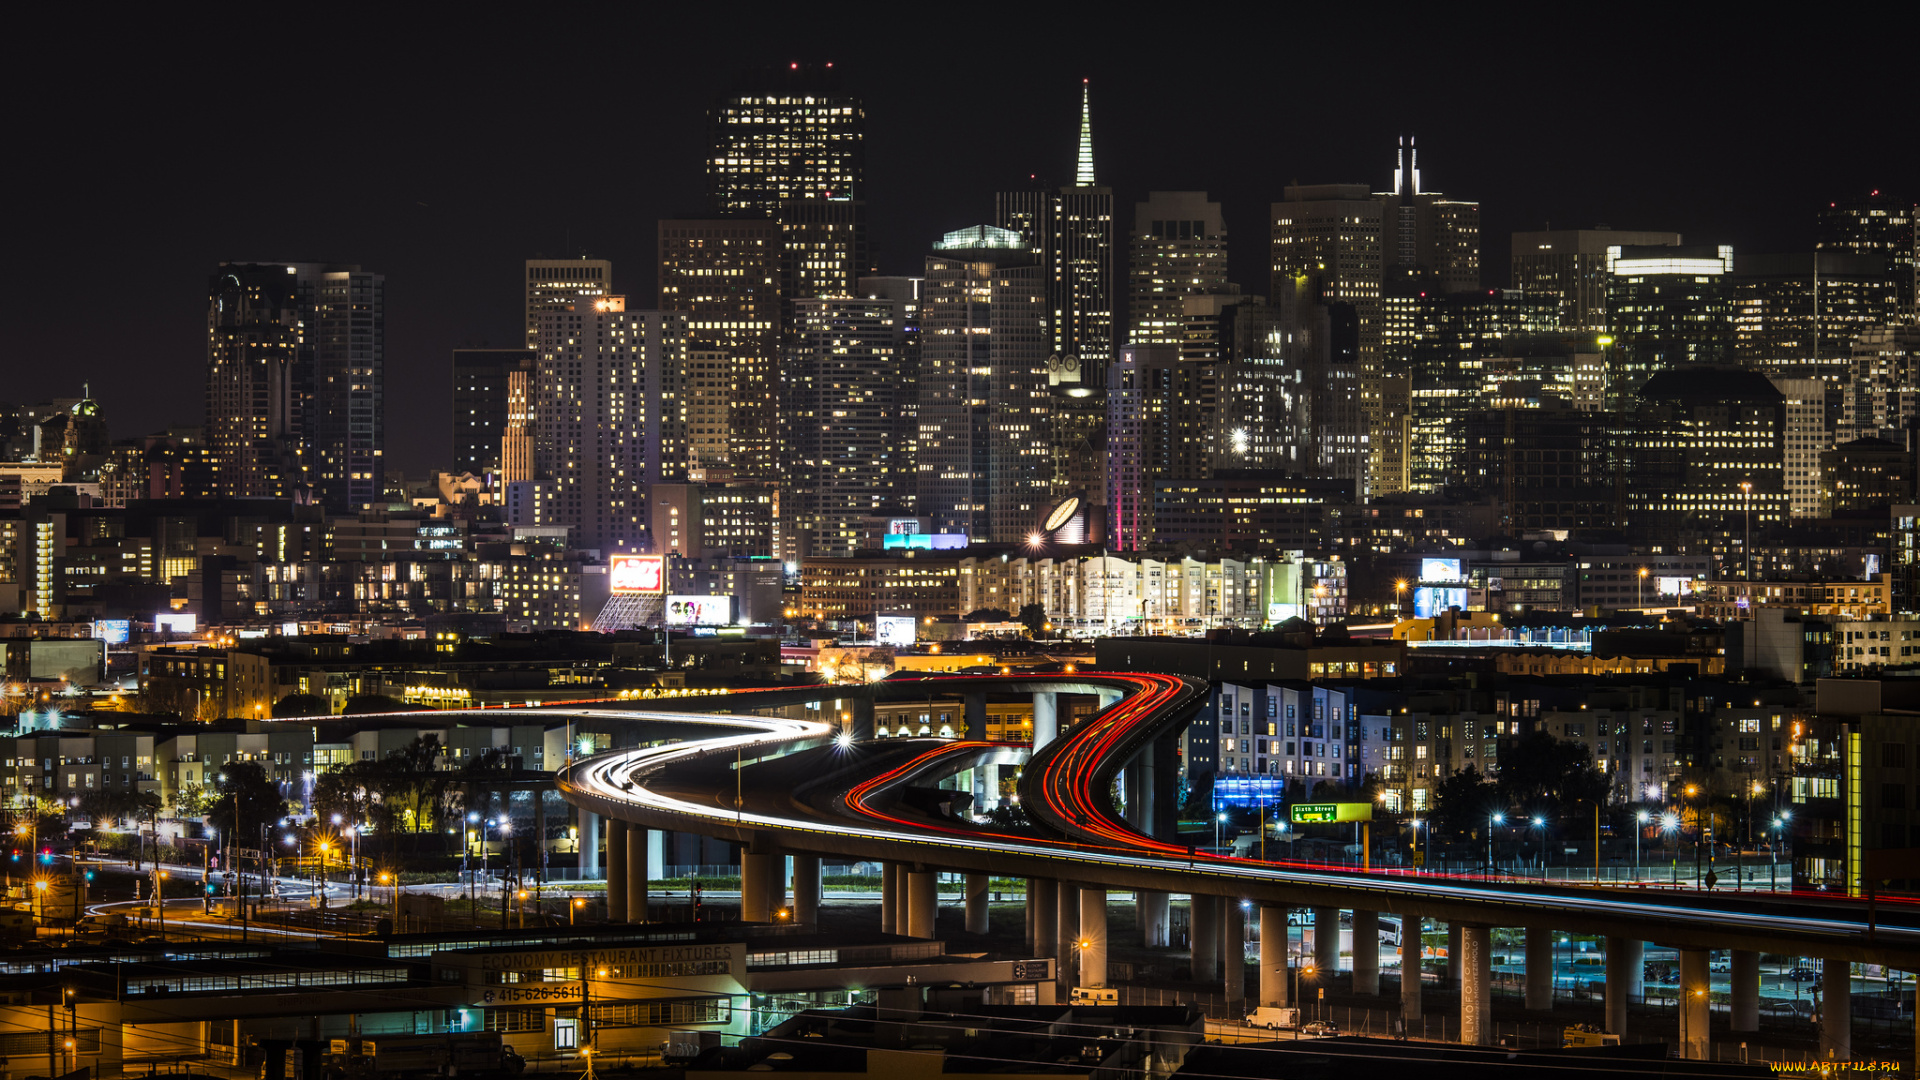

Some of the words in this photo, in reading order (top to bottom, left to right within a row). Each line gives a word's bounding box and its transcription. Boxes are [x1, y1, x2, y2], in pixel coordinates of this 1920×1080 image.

[482, 953, 555, 970] ECONOMY
[560, 949, 658, 967] RESTAURANT
[662, 946, 732, 962] FIXTURES
[277, 995, 322, 1007] SHIPPING
[499, 986, 581, 1001] 415-626-5611
